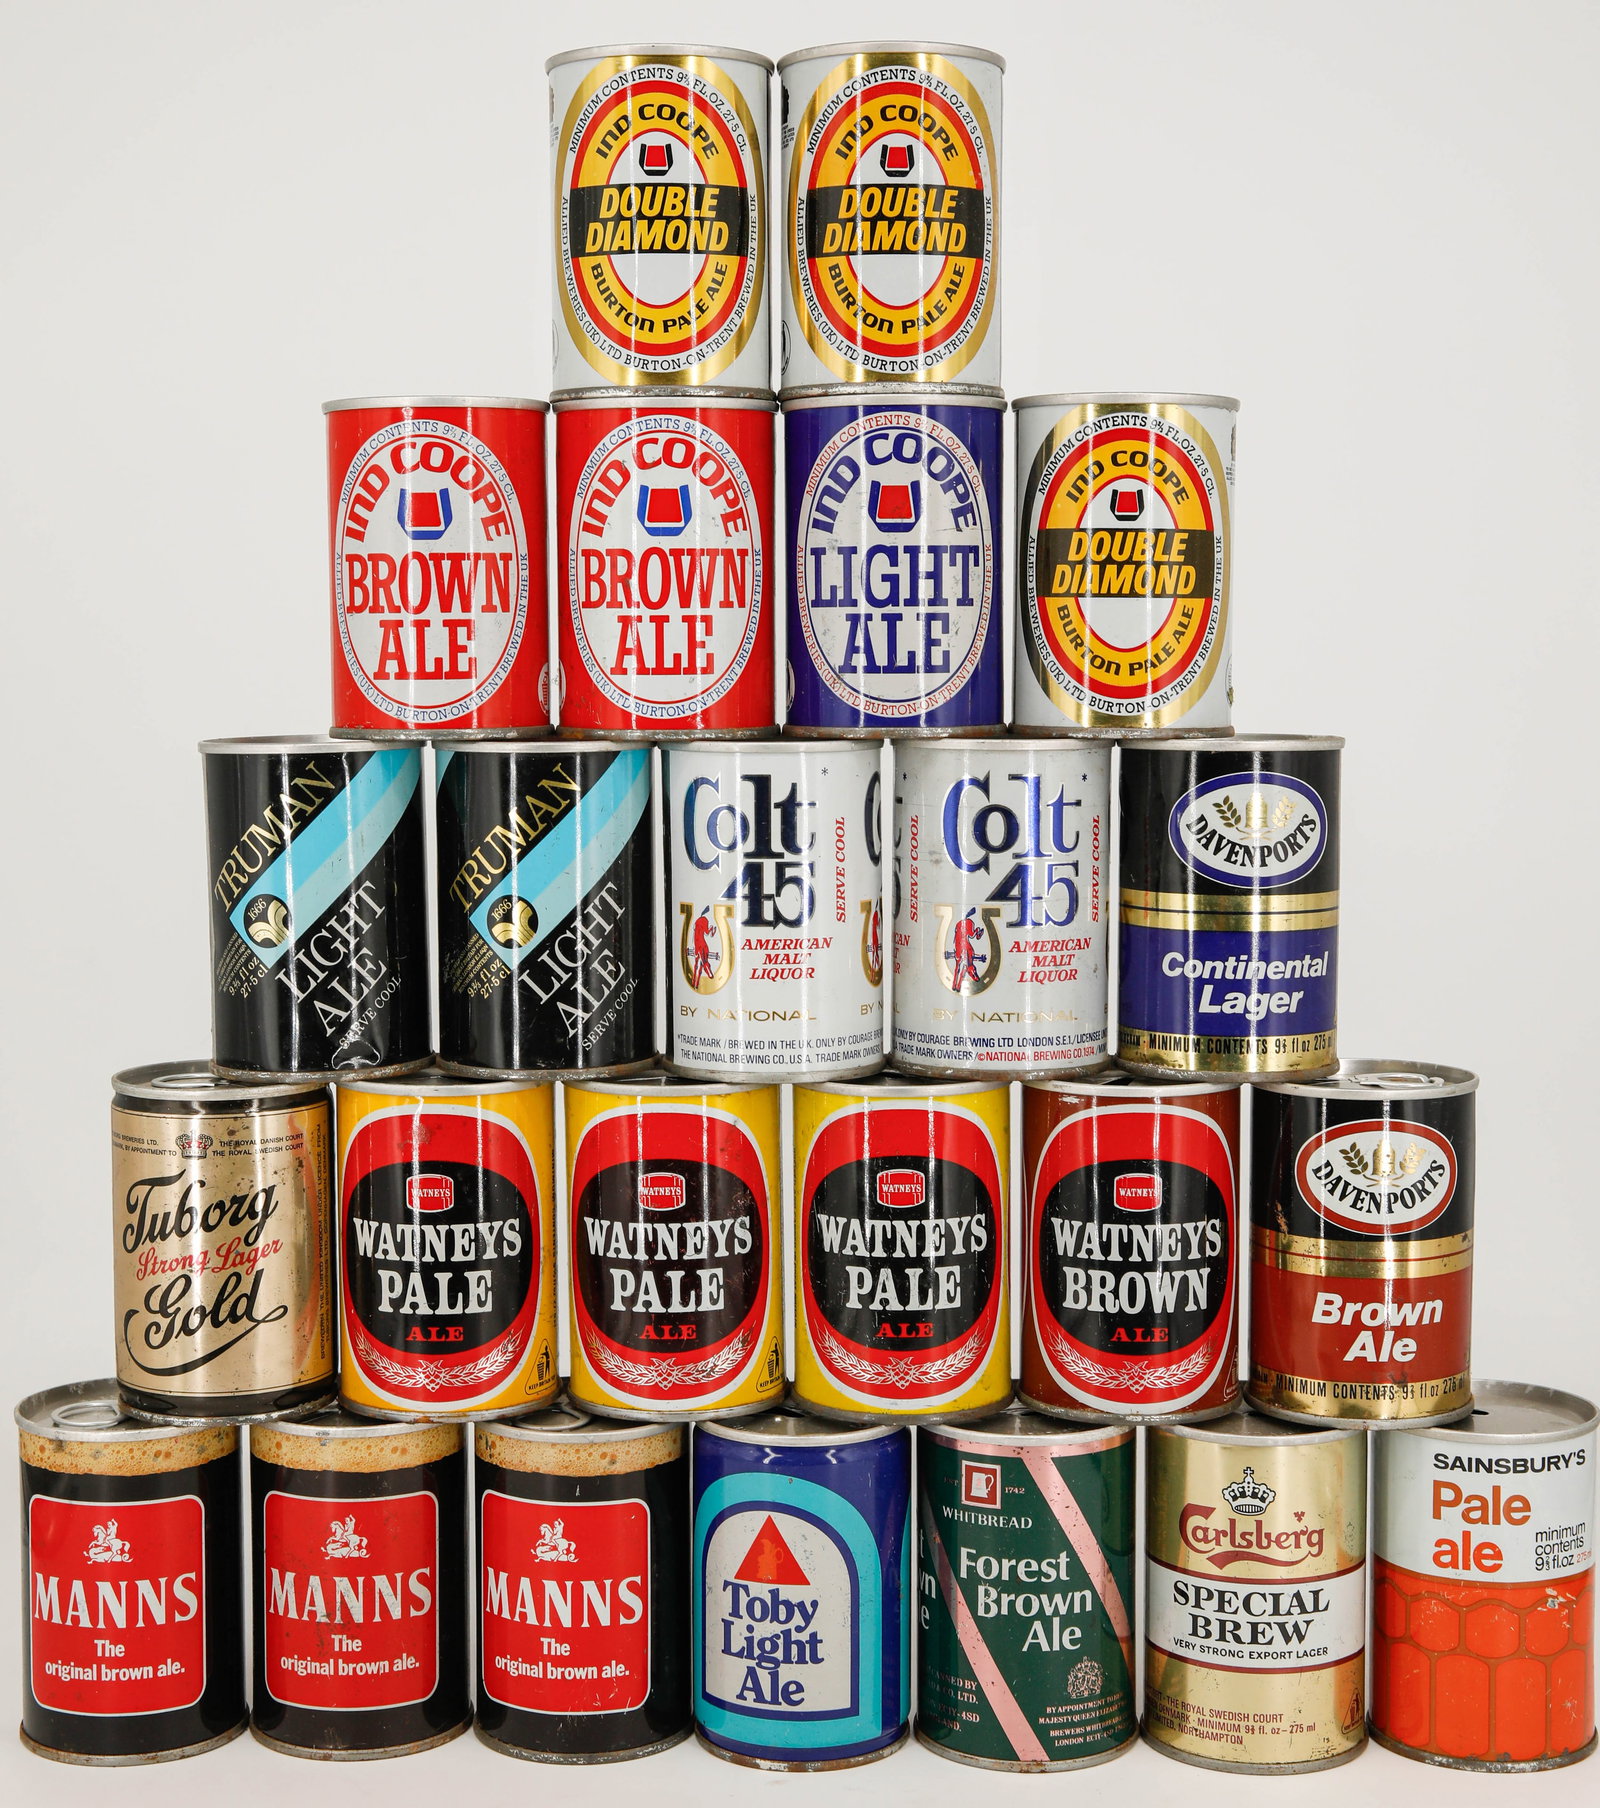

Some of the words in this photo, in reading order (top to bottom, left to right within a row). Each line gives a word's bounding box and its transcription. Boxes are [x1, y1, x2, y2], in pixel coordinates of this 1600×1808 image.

[570, 94, 603, 154] MINIMUM
[602, 68, 674, 97] CONTENTS
[596, 112, 631, 160] IND
[638, 104, 719, 160] COOPE
[835, 114, 874, 161] IND
[880, 105, 958, 161] COOPE
[599, 186, 720, 219] DOUBLE
[750, 194, 756, 212] UK
[839, 186, 958, 219] DOUBLE
[586, 220, 729, 253] DIAMOND
[750, 249, 756, 260] IN
[823, 221, 967, 254] DIAMOND
[563, 249, 587, 322] BREWERIES
[592, 263, 654, 333] BURTON
[663, 298, 710, 333] PALE
[706, 261, 728, 301] ALE
[735, 265, 754, 319] BREWED
[828, 263, 893, 334] BURTON
[902, 299, 947, 334] PALE
[944, 264, 965, 303] ALE
[600, 340, 622, 360] LTD
[342, 448, 370, 504] MINIMUM
[370, 421, 439, 450] CONTENTS
[1066, 459, 1105, 503] IND
[1111, 450, 1189, 505] COOPE
[345, 464, 390, 542] IND
[390, 441, 510, 542] COOPE
[582, 459, 631, 538] IND
[632, 437, 747, 538] COOPE
[812, 455, 861, 534] IND
[864, 433, 977, 532] COOPE
[1068, 531, 1189, 562] DOUBLE
[345, 552, 513, 615] BROWN
[581, 546, 748, 610] BROWN
[810, 545, 979, 609] LIGHT
[1052, 564, 1196, 596] DIAMOND
[373, 619, 477, 681] ALE
[610, 615, 715, 675] ALE
[839, 613, 950, 674] ALE
[1057, 605, 1121, 676] BURTON
[1129, 642, 1176, 676] PALE
[1174, 606, 1194, 645] ALE
[214, 760, 335, 913] TRUMAN
[450, 762, 581, 914] TRUMAN
[683, 774, 817, 871] Colt
[835, 817, 845, 863] COOL
[943, 770, 1082, 876] Colt
[1092, 816, 1100, 862] COOL
[1186, 814, 1318, 868] DAVENPORTS
[248, 898, 267, 922] 1666
[720, 860, 817, 929] 45
[836, 867, 847, 924] SERVE
[985, 859, 1080, 928] 45
[1091, 868, 1100, 923] SERVE
[275, 880, 387, 1005] LIGHT
[518, 881, 626, 1005] LIGHT
[741, 937, 833, 951] AMERICAN
[763, 952, 812, 965] MALT
[1009, 938, 1092, 953] AMERICAN
[1032, 954, 1075, 968] MALT
[750, 967, 816, 981] LIQUOR
[1017, 968, 1078, 983] LIQUOR
[1162, 951, 1329, 980] Continental
[313, 947, 388, 1038] ALE
[339, 1008, 377, 1050] SERVE
[374, 976, 402, 1009] COOL
[556, 950, 626, 1039] ALE
[1199, 985, 1304, 1021] Lager
[581, 1009, 618, 1052] SERVE
[614, 978, 638, 1010] COOL
[680, 1006, 697, 1018] BY
[707, 1007, 817, 1022] NATIONAL
[917, 1033, 950, 1046] COURAGE
[998, 1037, 1013, 1047] LTD
[1018, 1036, 1054, 1047] LONDON
[1034, 1050, 1072, 1061] BREWING
[1149, 1034, 1200, 1053] MINIMUM
[1207, 1038, 1268, 1055] CONTENTS
[1292, 1038, 1299, 1052] fl
[1301, 1040, 1310, 1052] oz
[1314, 1035, 1326, 1051] 275
[260, 1136, 284, 1145] DANISH
[285, 1133, 304, 1141] COURT
[285, 1142, 304, 1151] COURT
[411, 1188, 451, 1199] WATNEYS
[640, 1185, 682, 1196] WATNEYS
[881, 1183, 922, 1194] WATNEYS
[1119, 1187, 1159, 1198] WATNEYS
[1312, 1159, 1446, 1215] DAVENPORTS
[122, 1168, 279, 1254] Tuborg
[353, 1218, 522, 1263] WATNEYS
[584, 1216, 753, 1261] WATNEYS
[818, 1213, 988, 1258] WATNEYS
[1051, 1218, 1222, 1263] WATNEYS
[137, 1246, 210, 1282] Strong
[211, 1236, 284, 1277] Lager
[378, 1269, 493, 1315] PALE
[610, 1268, 725, 1313] PALE
[846, 1265, 961, 1311] PALE
[1062, 1266, 1210, 1315] BROWN
[125, 1268, 288, 1372] Gold
[1311, 1292, 1444, 1327] Brown
[406, 1326, 465, 1342] ALE
[639, 1324, 698, 1340] ALE
[876, 1323, 934, 1338] ALE
[1110, 1327, 1169, 1343] ALE
[1343, 1331, 1417, 1363] Ale
[1276, 1375, 1327, 1398] MINIMUM
[1333, 1384, 1395, 1401] CONTENTS
[1433, 1449, 1586, 1475] SAINSBURY'S
[943, 1505, 1033, 1529] WHITBREAD
[1432, 1479, 1532, 1526] Pale
[1179, 1502, 1325, 1564] Carlsberg
[1432, 1530, 1504, 1574] ale
[1535, 1536, 1584, 1556] contents
[1536, 1522, 1586, 1543] minimum
[960, 1547, 1071, 1583] Forest
[34, 1572, 199, 1629] MANNS
[269, 1566, 432, 1625] MANNS
[485, 1566, 644, 1629] MANNS
[723, 1580, 819, 1633] Toby
[977, 1584, 1093, 1618] Brown
[1173, 1579, 1330, 1618] SPECIAL
[94, 1639, 126, 1658] The
[331, 1634, 362, 1652] The
[540, 1637, 570, 1656] The
[721, 1618, 825, 1670] Light
[1022, 1620, 1082, 1653] Ale
[1173, 1637, 1197, 1652] VERY
[1199, 1644, 1244, 1660] STRONG
[1249, 1649, 1294, 1661] EXPORT
[1296, 1646, 1329, 1660] LAGER
[1188, 1612, 1315, 1647] BREW
[45, 1663, 97, 1682] original
[101, 1662, 154, 1682] brown
[157, 1660, 186, 1678] ale.
[280, 1655, 334, 1676] original
[338, 1658, 389, 1676] brown
[393, 1654, 420, 1672] ale.
[495, 1655, 543, 1679] original
[547, 1663, 597, 1680] brown
[602, 1660, 630, 1678] ale.
[736, 1666, 805, 1707] Ale
[1046, 1706, 1057, 1714] BY
[1058, 1700, 1105, 1713] APPOINTMENT
[1167, 1696, 1179, 1709] THE
[1181, 1701, 1207, 1717] ROYAL
[1209, 1708, 1250, 1722] SWEDISH
[1253, 1713, 1284, 1724] COURT
[1197, 1717, 1241, 1733] MINIMUM
[1055, 1737, 1084, 1747] LONDON
[1178, 1724, 1244, 1745] NORTHAMPTON
